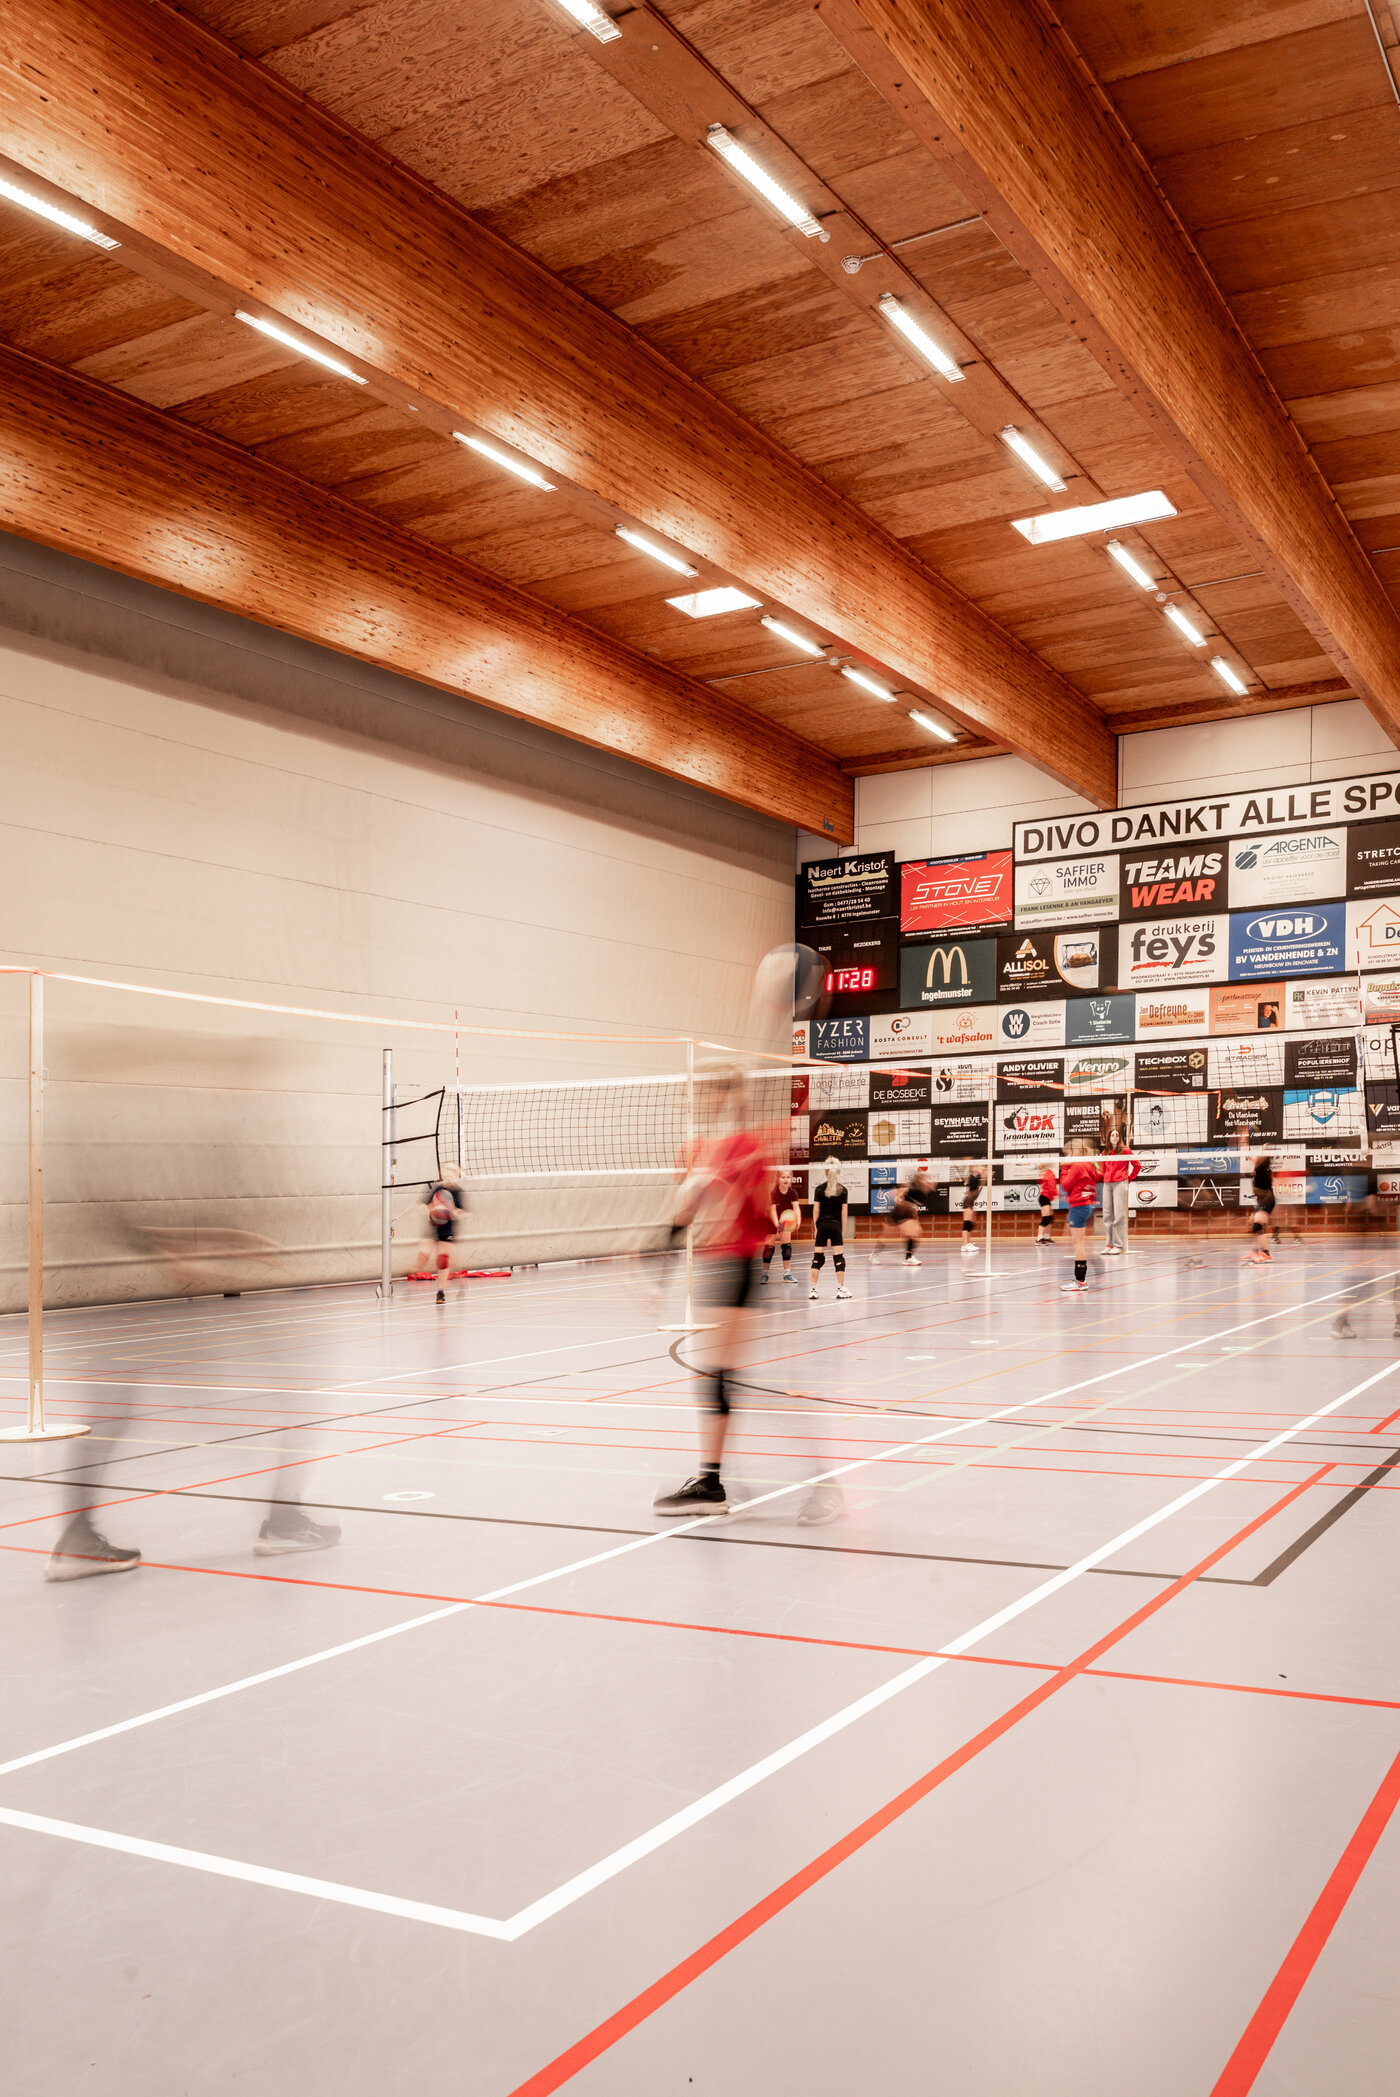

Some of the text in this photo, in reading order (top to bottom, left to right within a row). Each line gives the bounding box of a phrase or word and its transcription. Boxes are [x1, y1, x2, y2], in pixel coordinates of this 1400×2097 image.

[1023, 782, 1400, 854] DIVO DANKT ALLE SP
[1263, 836, 1339, 855] ARGENTA
[807, 866, 842, 879] Naert
[1056, 863, 1105, 878] SAFFIER
[1124, 853, 1223, 885] TEAMS
[911, 875, 1002, 902] STOVE
[1063, 875, 1097, 888] IMMO
[1131, 879, 1216, 908] WEAR
[1039, 902, 1064, 910] LESENNE
[1079, 897, 1114, 906] VANGAEVER
[1152, 920, 1215, 937] drukkerij
[1258, 917, 1314, 938] VDH
[853, 940, 882, 948] BEZOEKERS
[1130, 928, 1216, 969] feys
[1235, 955, 1248, 964] BV
[1249, 949, 1315, 962] VANDENHENDE
[1326, 947, 1339, 956] ZN
[1003, 959, 1050, 973] ALLISOL
[827, 970, 873, 991] 11:28
[921, 988, 973, 1002] Ingelmunster
[1215, 990, 1262, 1003] Sportmassage
[1330, 986, 1359, 994] PATTYN
[1149, 1004, 1188, 1020] Defreyne
[816, 1020, 864, 1038] YZER
[817, 1037, 864, 1049] FASHION
[946, 1032, 993, 1044] wafsalon
[1002, 1062, 1059, 1073] ANDY OLIVIER
[1138, 1056, 1187, 1065] TECHBOX
[1298, 1058, 1350, 1066] POPULIERENHOF
[1078, 1061, 1120, 1075] Vergro
[873, 1088, 927, 1100] DE BOSBEKE
[1066, 1105, 1100, 1116] WINDELS
[934, 1116, 980, 1126] SEYNHAEVE
[1016, 1114, 1056, 1131] VDK
